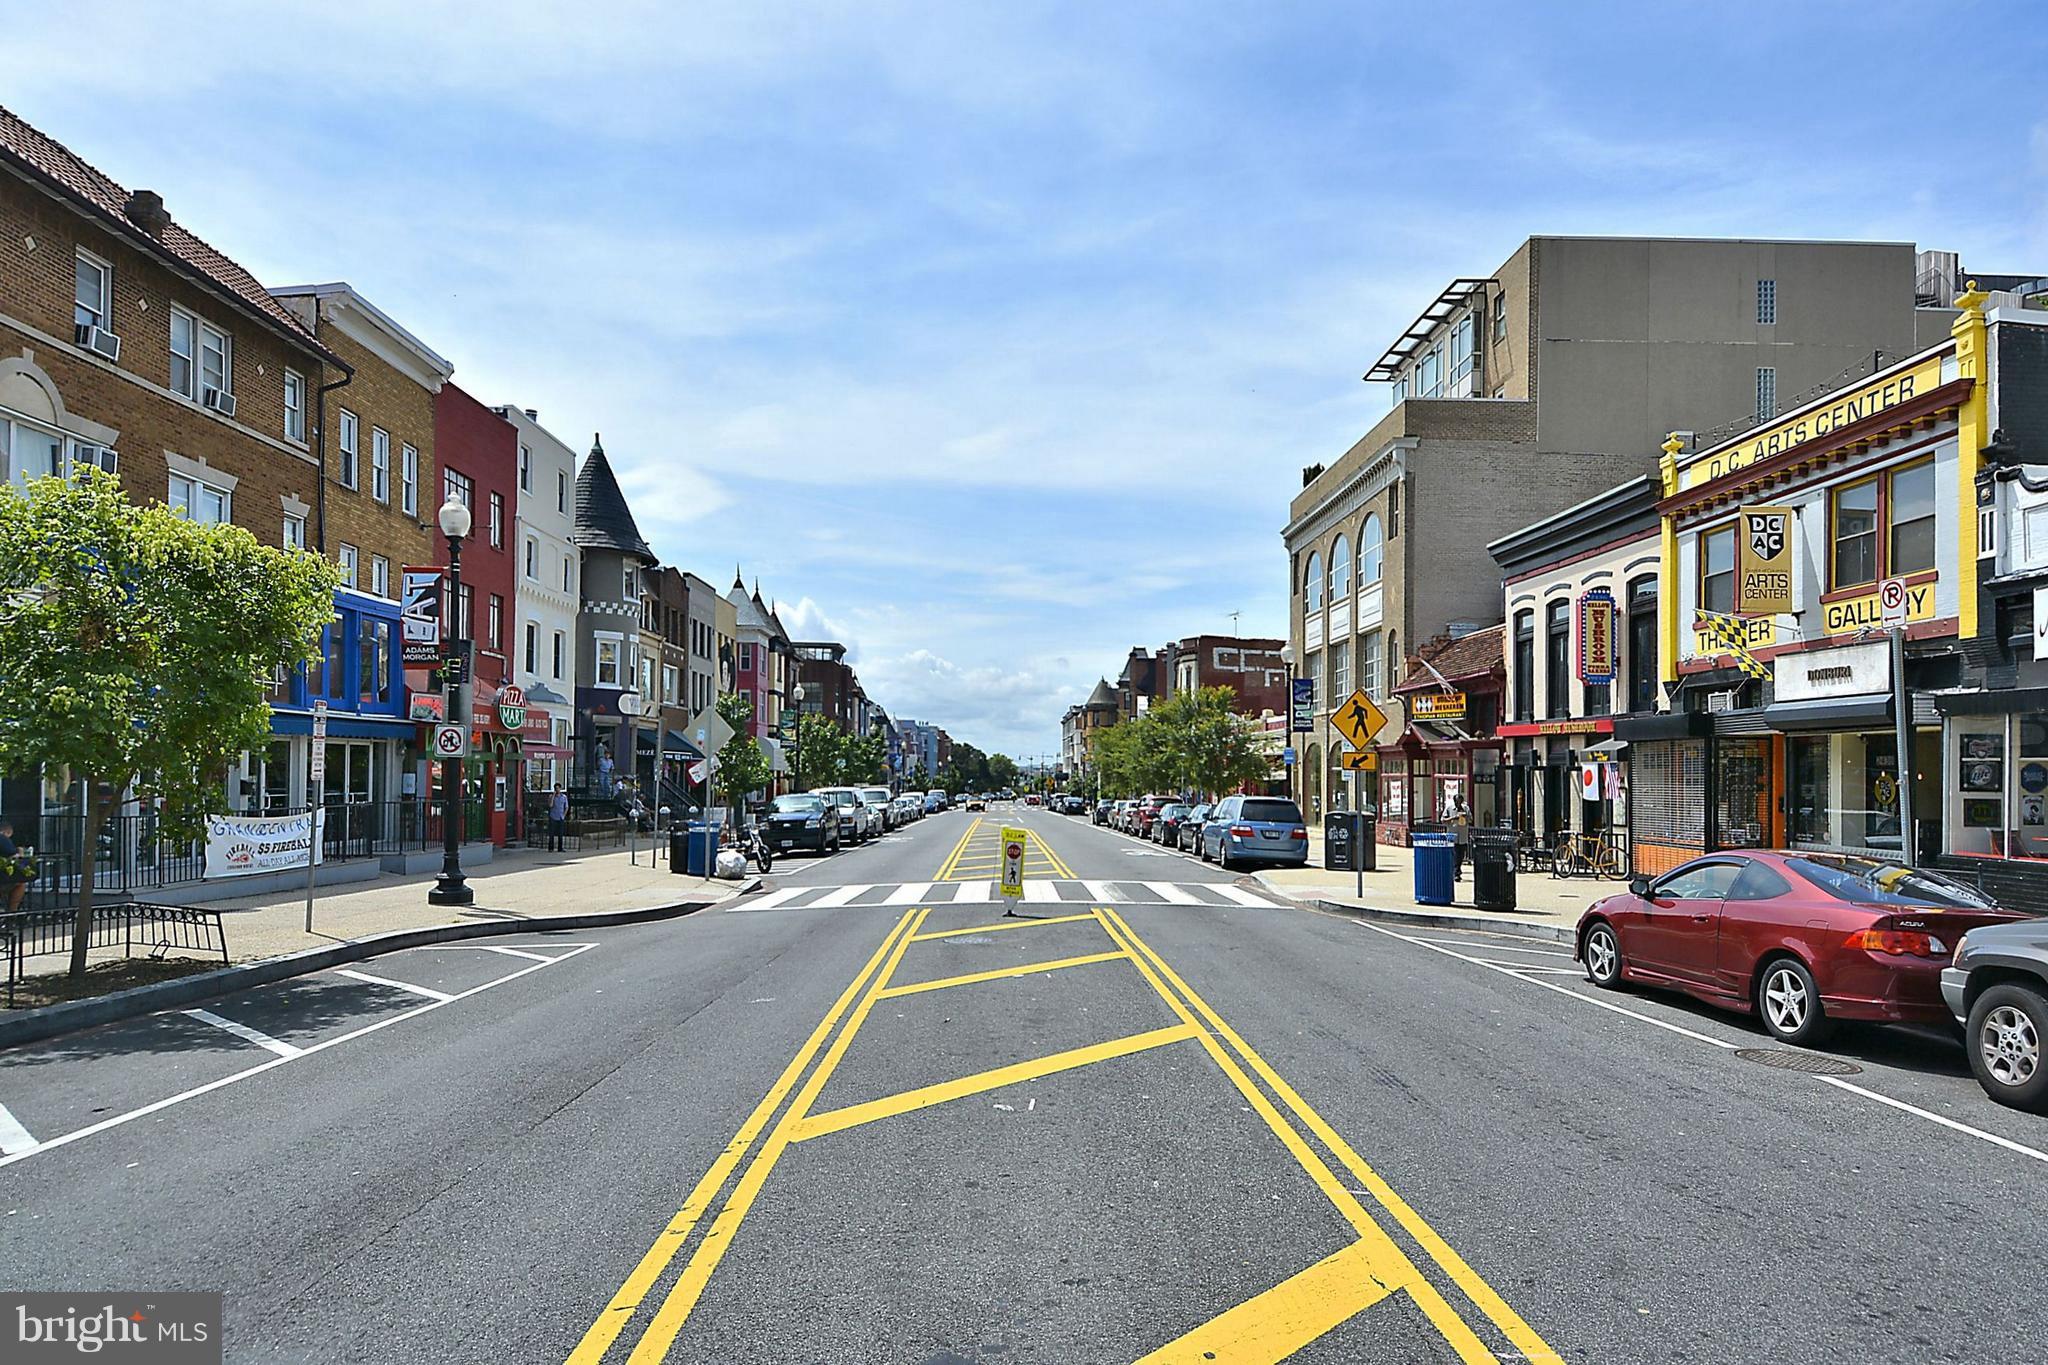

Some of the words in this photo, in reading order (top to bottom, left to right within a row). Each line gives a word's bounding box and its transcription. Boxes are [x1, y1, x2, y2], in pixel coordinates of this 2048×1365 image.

[1710, 451, 1745, 481] D.C.
[1753, 421, 1807, 463] ARTS
[1816, 375, 1915, 437] CENTER
[1745, 573, 1788, 588] ARTS
[1745, 588, 1788, 599] CENTER
[1828, 588, 1927, 629] GALLY
[1592, 609, 1606, 663] MUSHROOM
[1699, 620, 1770, 651] THER
[1807, 665, 1852, 681] DONBURI
[503, 690, 525, 706] PIZZA
[502, 707, 525, 724] MART
[225, 843, 255, 860] FIREBALL
[257, 842, 271, 855] $5
[271, 837, 312, 853] FIREBAL
